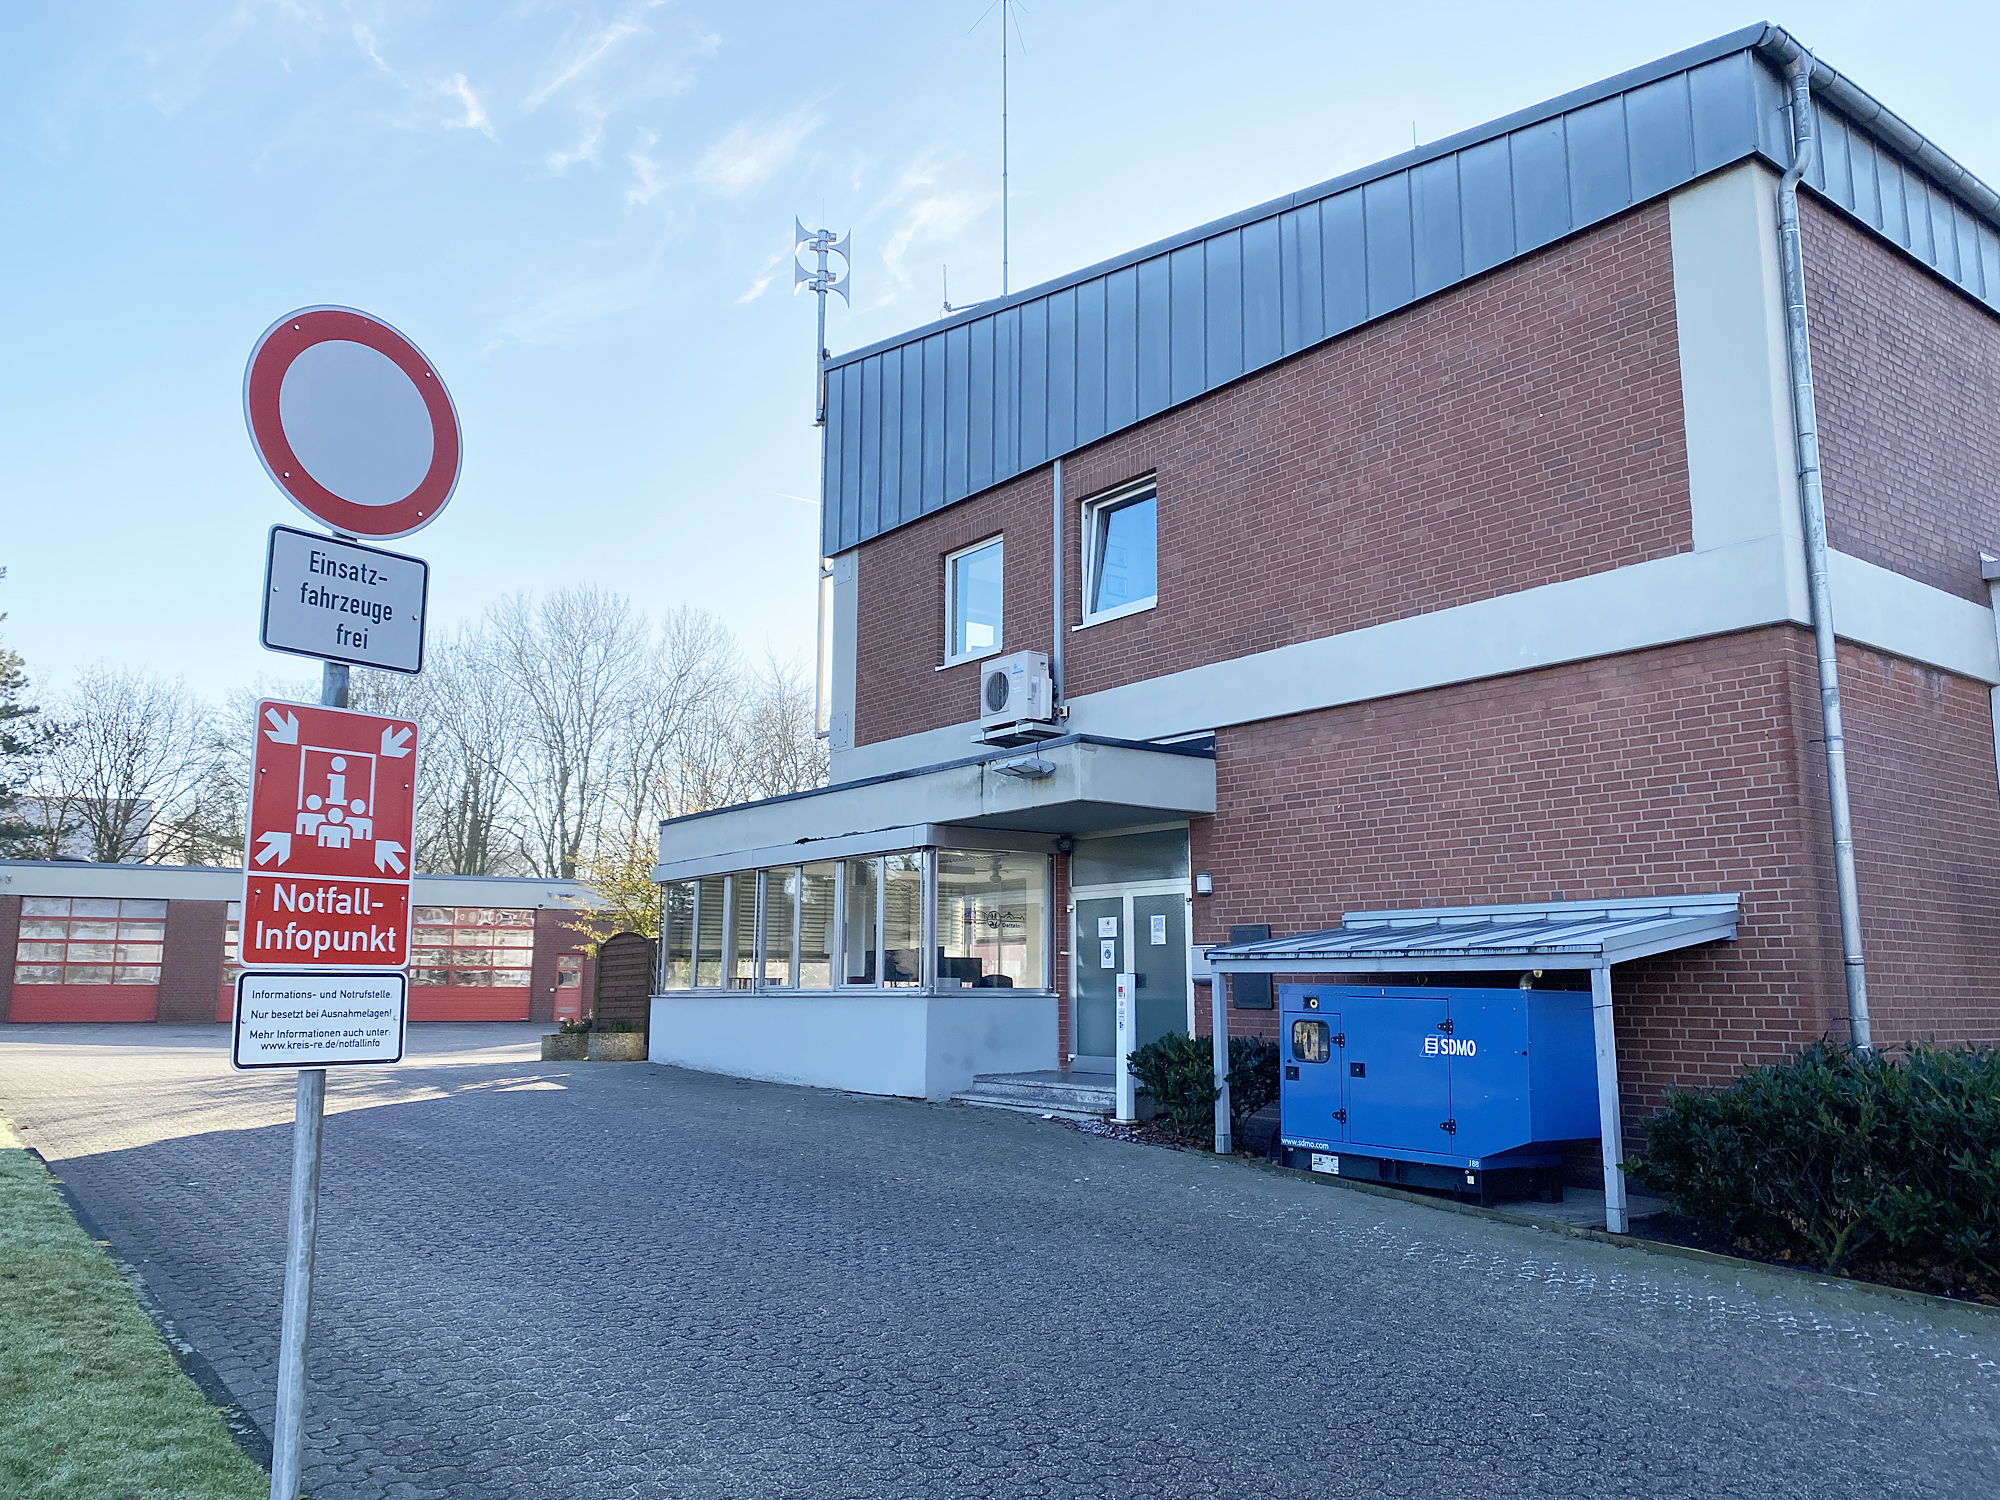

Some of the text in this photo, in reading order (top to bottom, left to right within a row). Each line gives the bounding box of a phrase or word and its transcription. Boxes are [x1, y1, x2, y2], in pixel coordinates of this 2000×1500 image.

[309, 550, 388, 586] Einsatz-
[300, 582, 393, 625] fahrzeuge
[335, 623, 369, 650] frei
[273, 883, 384, 916] Notfall-
[255, 920, 397, 959] Infopunkt
[252, 989, 393, 999] Informations- und Notrufstelle.
[250, 1008, 392, 1020] Nur besetzt bei Ausnahmelagen!
[249, 1028, 391, 1039] Mehr Informationen auch unter:
[260, 1038, 381, 1050] www.kreis-re.de/notfallinfo
[1440, 1038, 1477, 1057] SDMO
[1281, 1137, 1330, 1150] www.sdmo.com
